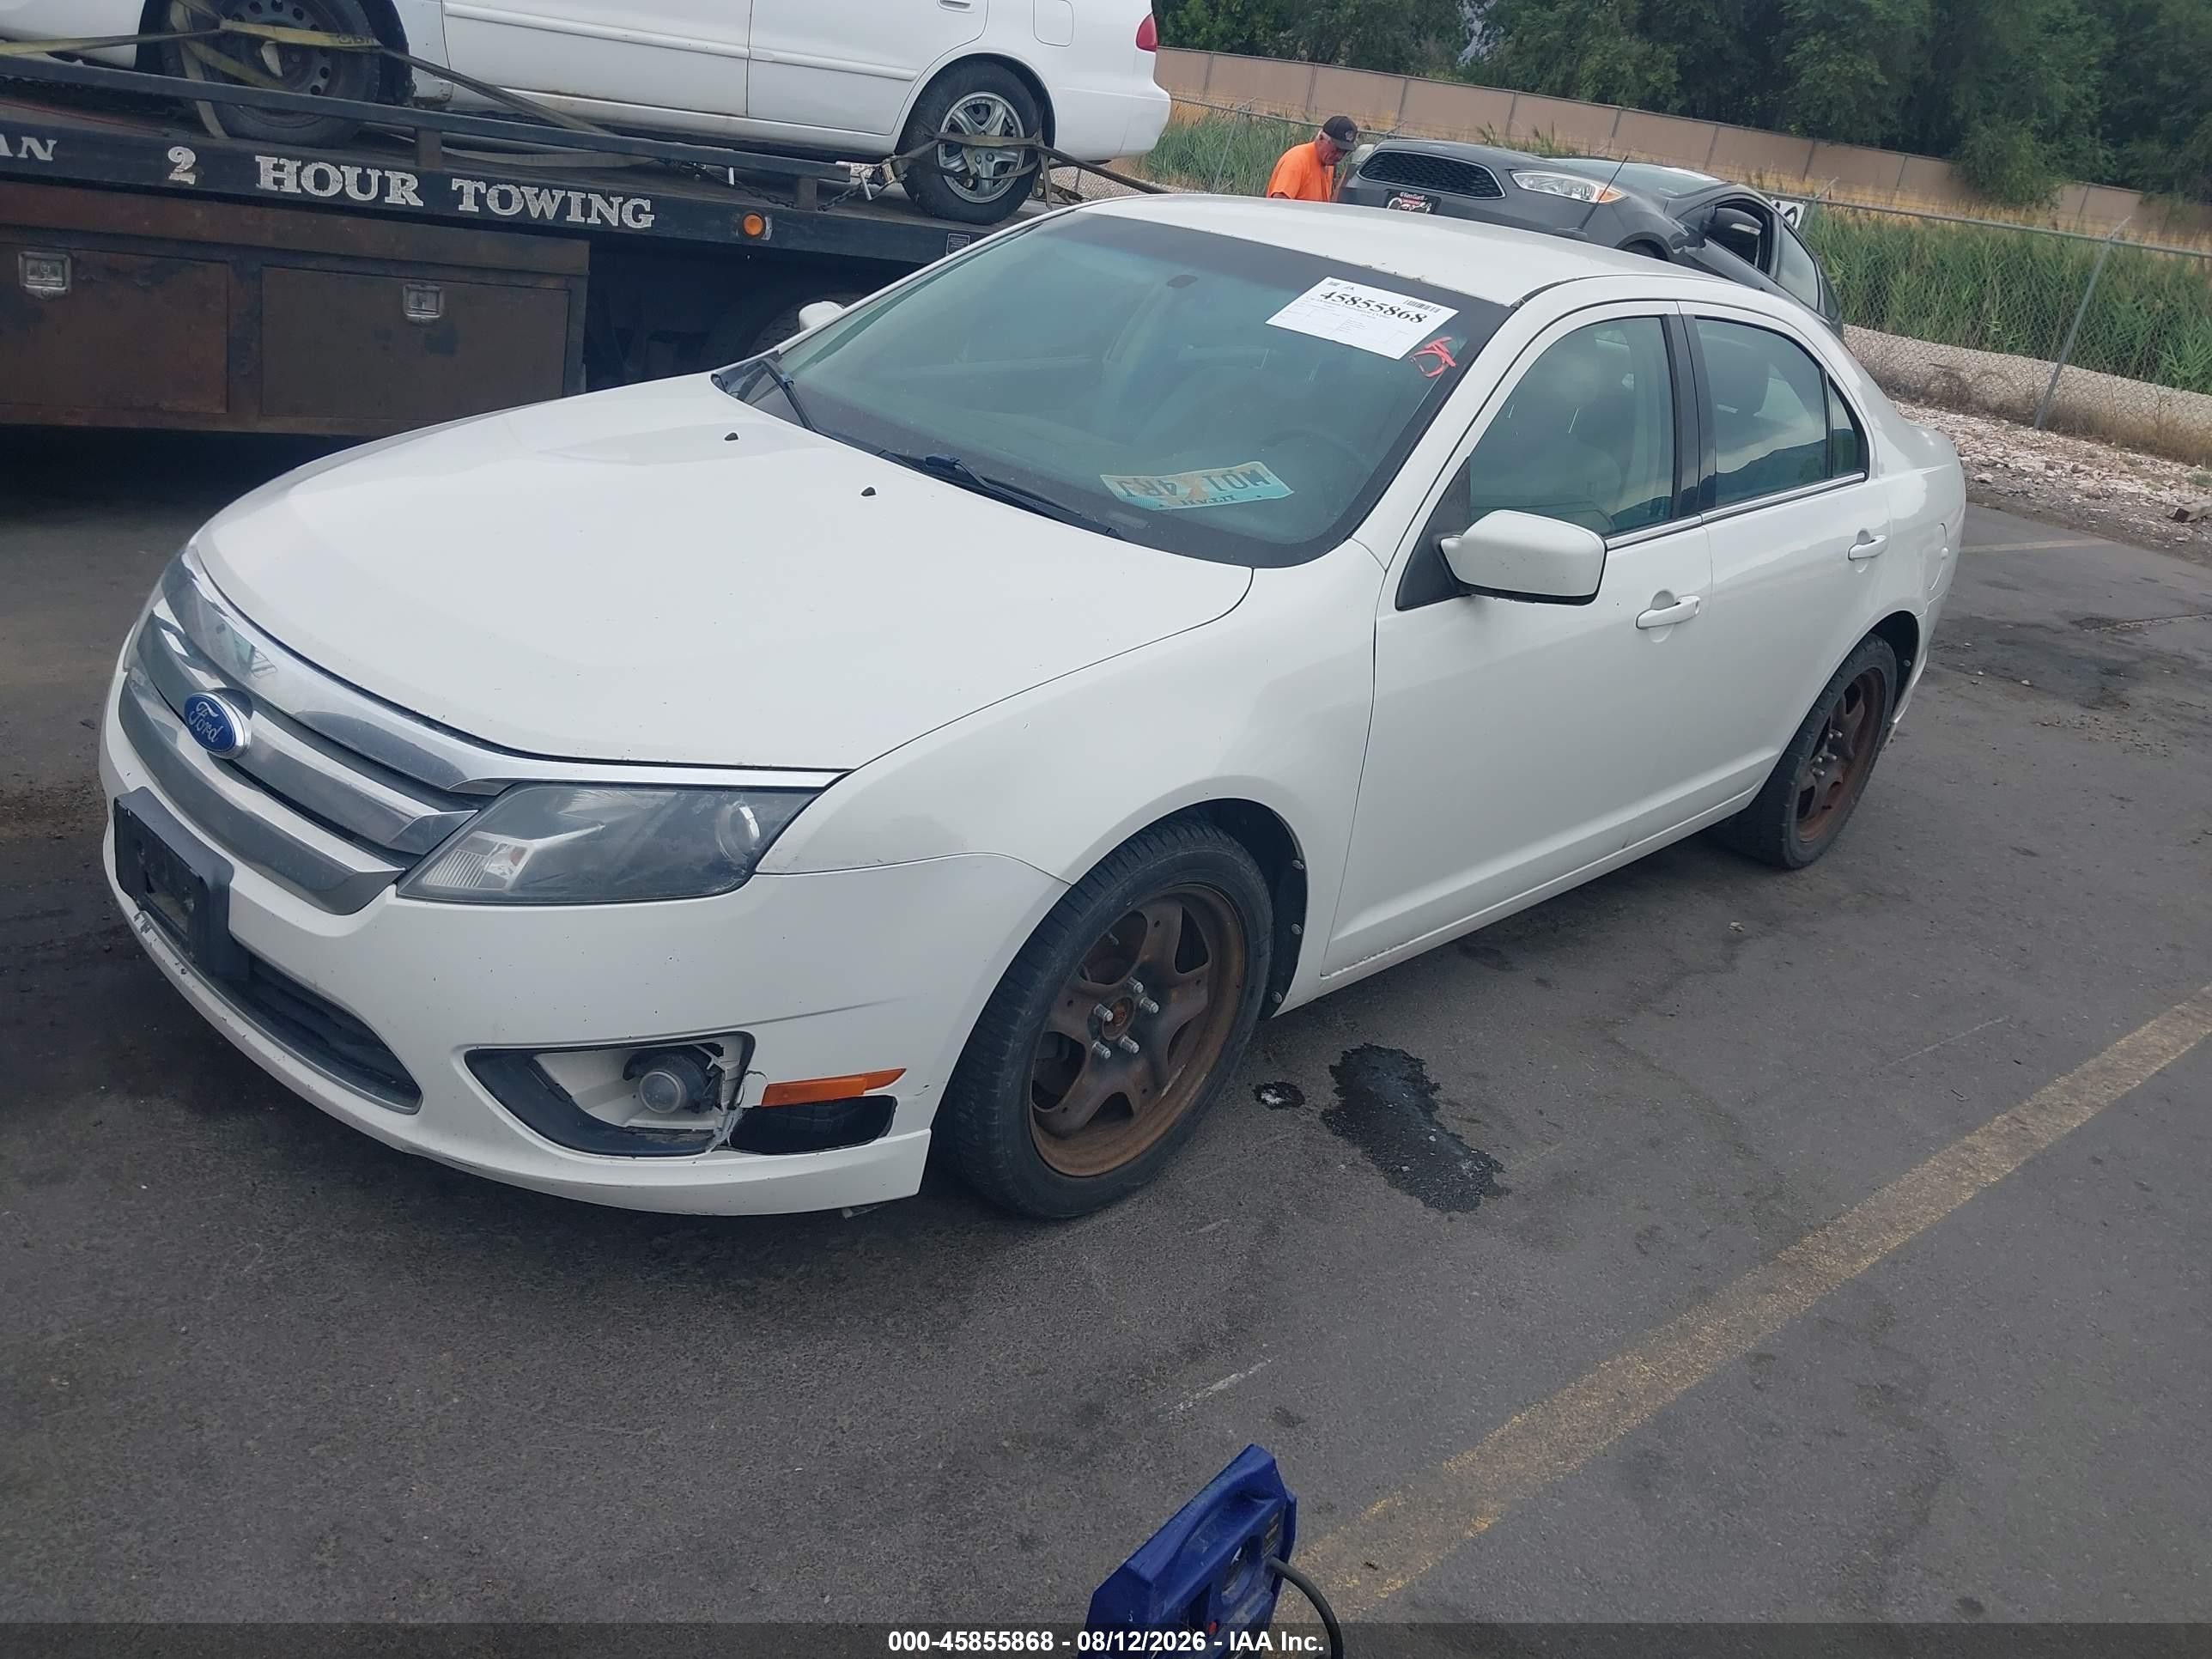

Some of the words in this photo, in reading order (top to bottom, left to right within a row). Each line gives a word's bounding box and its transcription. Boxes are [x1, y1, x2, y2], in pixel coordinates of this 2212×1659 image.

[167, 145, 197, 185] 2
[255, 155, 424, 207] HOUR
[451, 178, 655, 229] TOWING
[1320, 290, 1428, 325] 45855868
[189, 701, 224, 743] Ford
